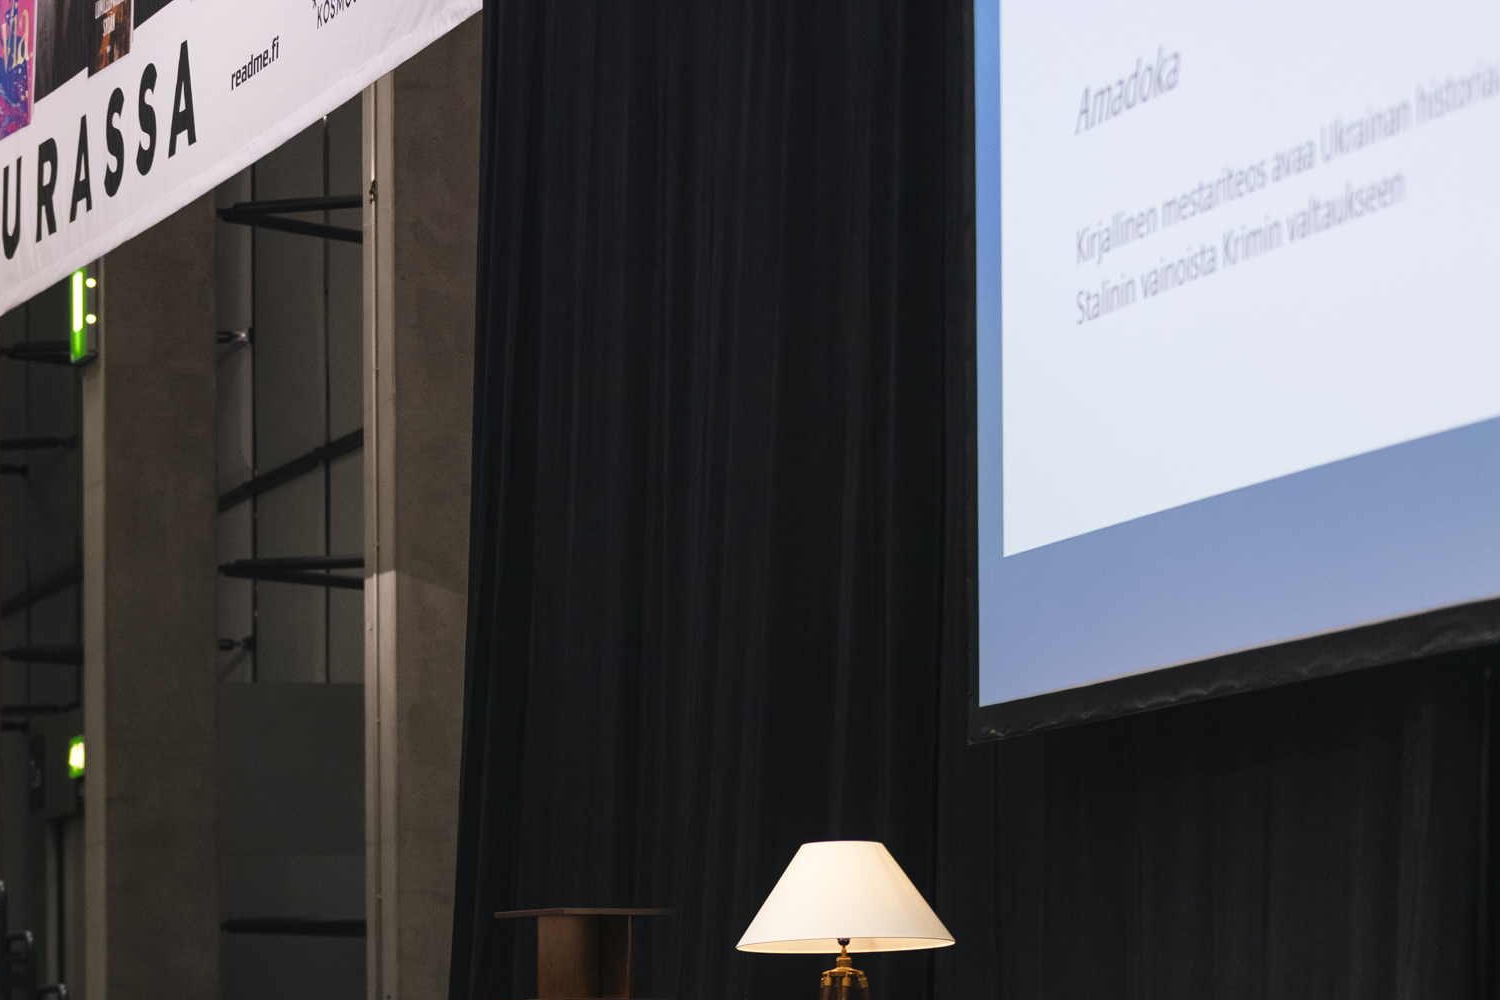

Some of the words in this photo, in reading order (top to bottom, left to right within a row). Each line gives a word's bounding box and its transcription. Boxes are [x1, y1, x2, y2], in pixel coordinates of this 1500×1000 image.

[317, 0, 357, 29] KOSM
[231, 35, 279, 91] readme.fi
[1074, 44, 1181, 136] Amadoka
[1076, 205, 1157, 265] Kirjallinen
[1162, 160, 1267, 229] mestariteos
[1271, 139, 1315, 183] avaa
[1320, 101, 1412, 163] Ukrainan
[1076, 273, 1136, 325] Stalinin
[1140, 245, 1217, 299] vainoista
[1222, 215, 1283, 268] Krimin
[1286, 172, 1407, 243] valtaukseen
